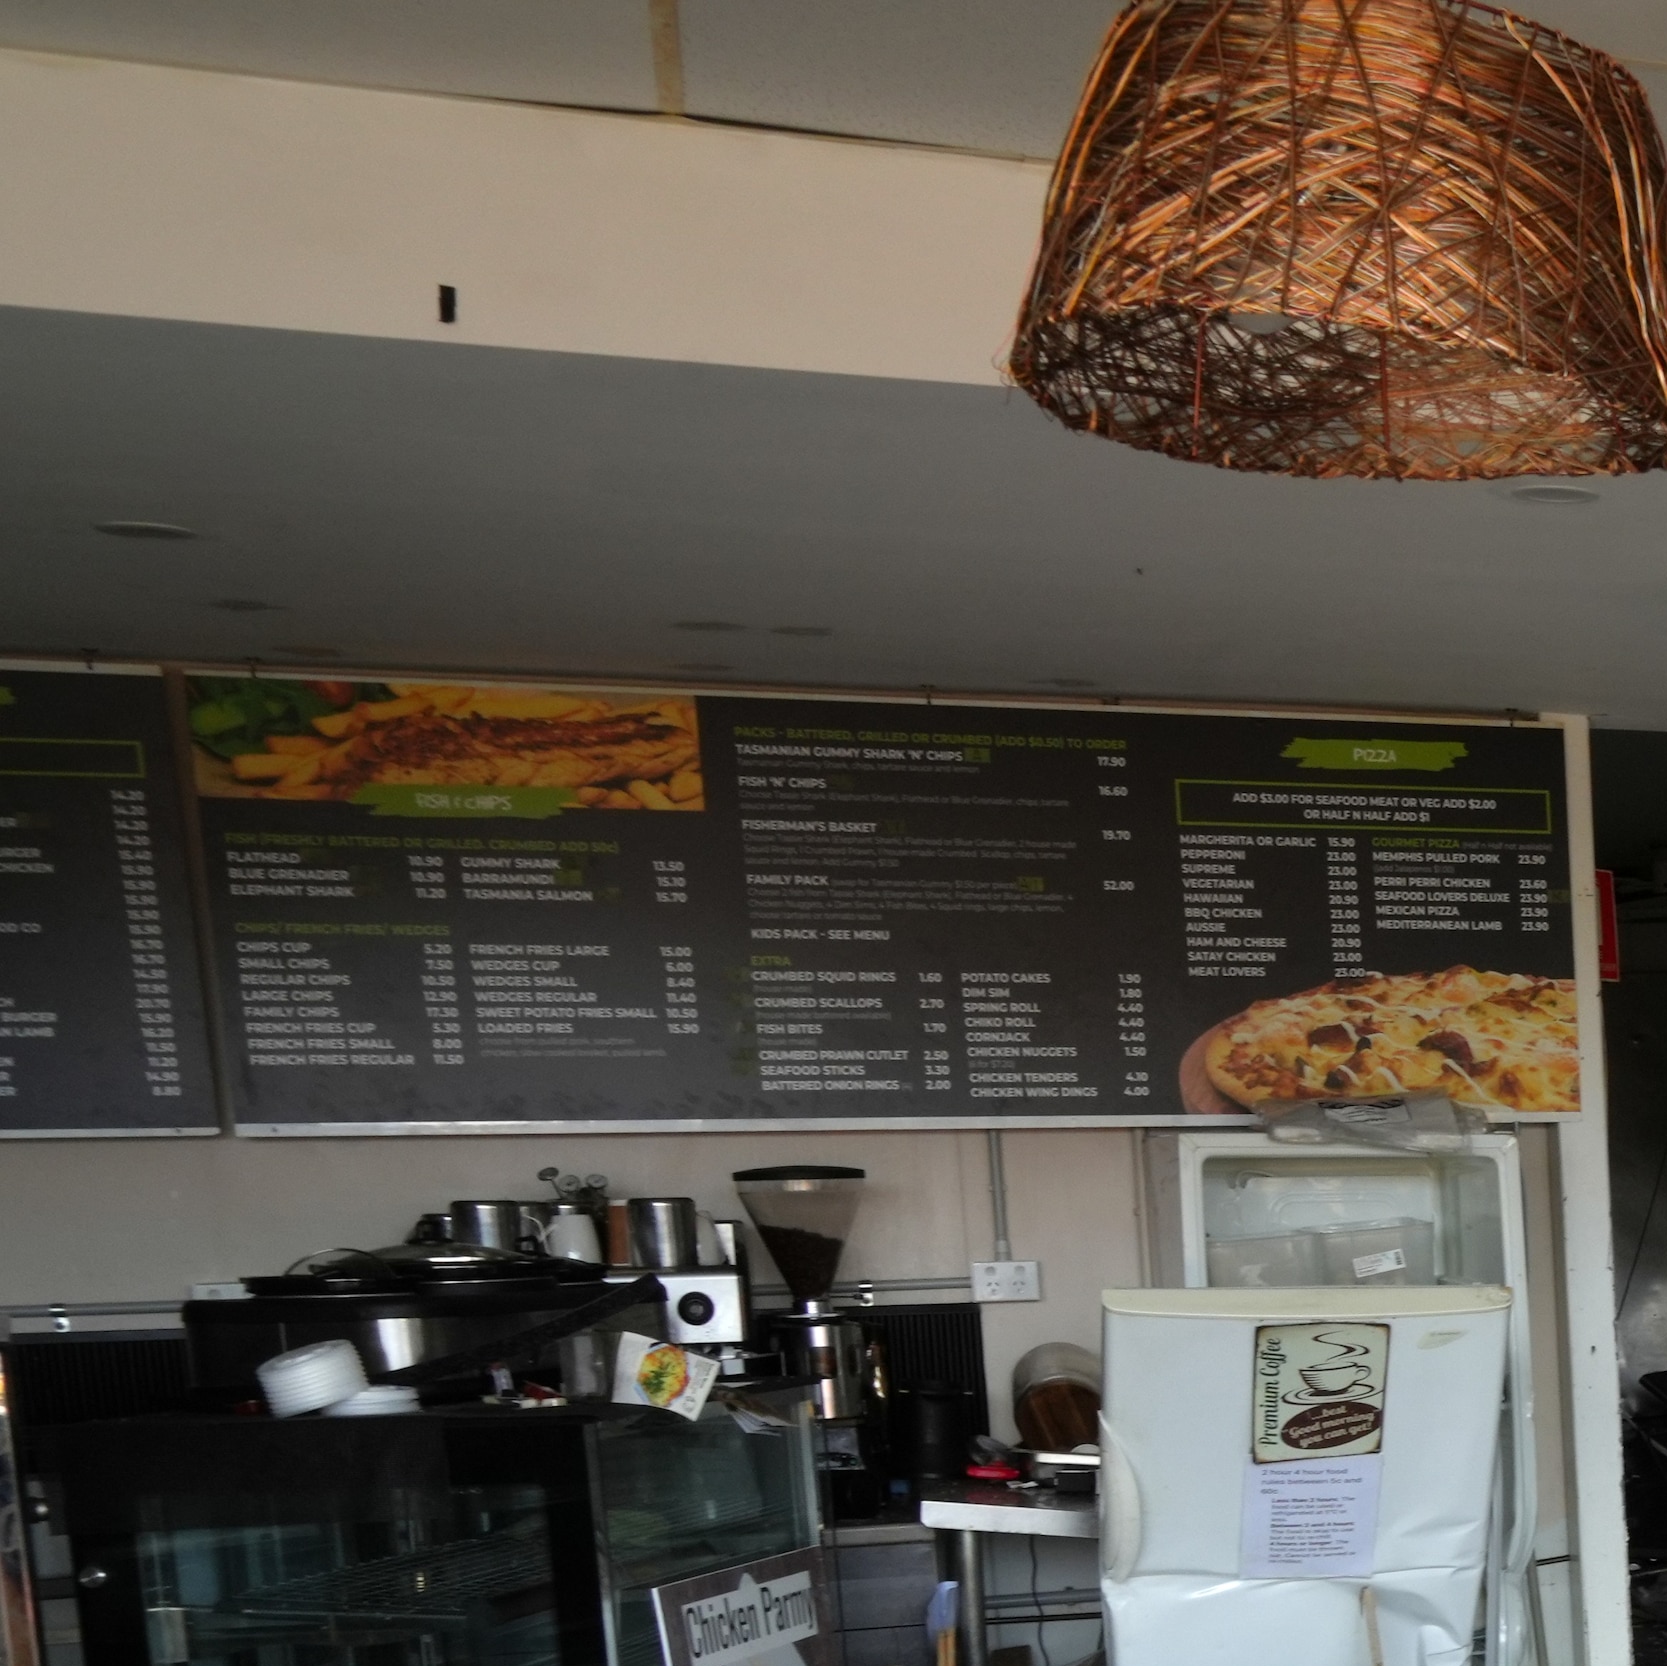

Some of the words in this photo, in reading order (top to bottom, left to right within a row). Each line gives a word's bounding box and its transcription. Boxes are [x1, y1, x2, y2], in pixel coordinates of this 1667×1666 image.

[735, 744, 811, 756] TASMANIAN
[813, 747, 860, 758] GUMMY
[863, 748, 905, 759] SHARK
[926, 750, 963, 761] CHIPS
[1097, 756, 1126, 767] 17.90
[1353, 748, 1396, 763] PIZZA
[415, 793, 449, 808] FISH
[464, 795, 513, 810] CHIPS
[1233, 793, 1258, 803] ADD
[1260, 793, 1289, 804] $3.00
[1291, 794, 1314, 804] FOR
[1315, 795, 1368, 806] SEAFOOD
[1369, 797, 1399, 806] MEAT
[1401, 797, 1417, 807] OR
[1419, 798, 1441, 808] VEG
[1442, 799, 1467, 808] ADD
[1468, 799, 1497, 810] $2.00
[1303, 809, 1320, 819] OR
[1322, 810, 1351, 820] HALF
[1352, 811, 1361, 820] N
[1363, 811, 1391, 821] HALF
[1393, 812, 1418, 821] ADD
[1419, 811, 1430, 822] $1
[742, 819, 826, 831] FISHERMAN'S
[828, 822, 877, 833] BASKET
[1102, 830, 1131, 840] 19.70
[1180, 835, 1255, 845] MARGHERITA
[1256, 836, 1273, 846] OR
[1275, 837, 1316, 847] GARLIC
[1328, 837, 1355, 847] 15.90
[1371, 837, 1426, 848] GOURMET
[1428, 838, 1460, 849] PIZZA
[1181, 849, 1245, 860] PEPPERONI
[1327, 851, 1356, 862] 23.00
[1373, 852, 1424, 862] MEMPHIS
[1426, 853, 1468, 863] PULLED
[1469, 854, 1500, 863] PORK
[1518, 855, 1546, 865] 23.90
[229, 868, 265, 879] BLUE
[268, 869, 349, 881] GRENADIER
[410, 872, 445, 883] 10.90
[462, 873, 555, 884] BARRAMUNDI
[746, 874, 792, 885] FAMILY
[794, 875, 829, 885] PACK
[1104, 880, 1134, 891] 52.00
[1374, 876, 1407, 886] PERRI
[1408, 877, 1441, 887] PERRI
[1443, 878, 1491, 888] CHICKEN
[1519, 879, 1547, 889] 23.60
[1184, 893, 1243, 903] HAWAIIAN
[1329, 895, 1359, 905] 20.90
[1184, 907, 1210, 919] BBQ
[1211, 908, 1262, 918] CHICKEN
[1330, 909, 1360, 919] 23.00
[1186, 937, 1214, 946] HAM
[1216, 937, 1241, 947] AND
[1243, 937, 1287, 947] CHEESE
[1332, 938, 1361, 948] 20.90
[750, 955, 792, 966] EXTRA
[750, 971, 815, 981] CRUMBED
[817, 971, 856, 983] SQUID
[858, 972, 896, 982] RINGS
[919, 972, 942, 983] 1.60
[961, 972, 1009, 983] POTATO
[1011, 973, 1051, 983] CAKES
[1118, 974, 1141, 984] 1.90
[1260, 1338, 1287, 1377] Coffee
[1259, 1380, 1279, 1445] Premium
[1288, 1421, 1320, 1439] Good
[1321, 1412, 1374, 1429] morning
[1324, 1428, 1347, 1439] can
[686, 1597, 761, 1658] Chicken
[760, 1586, 813, 1635] Parmy
